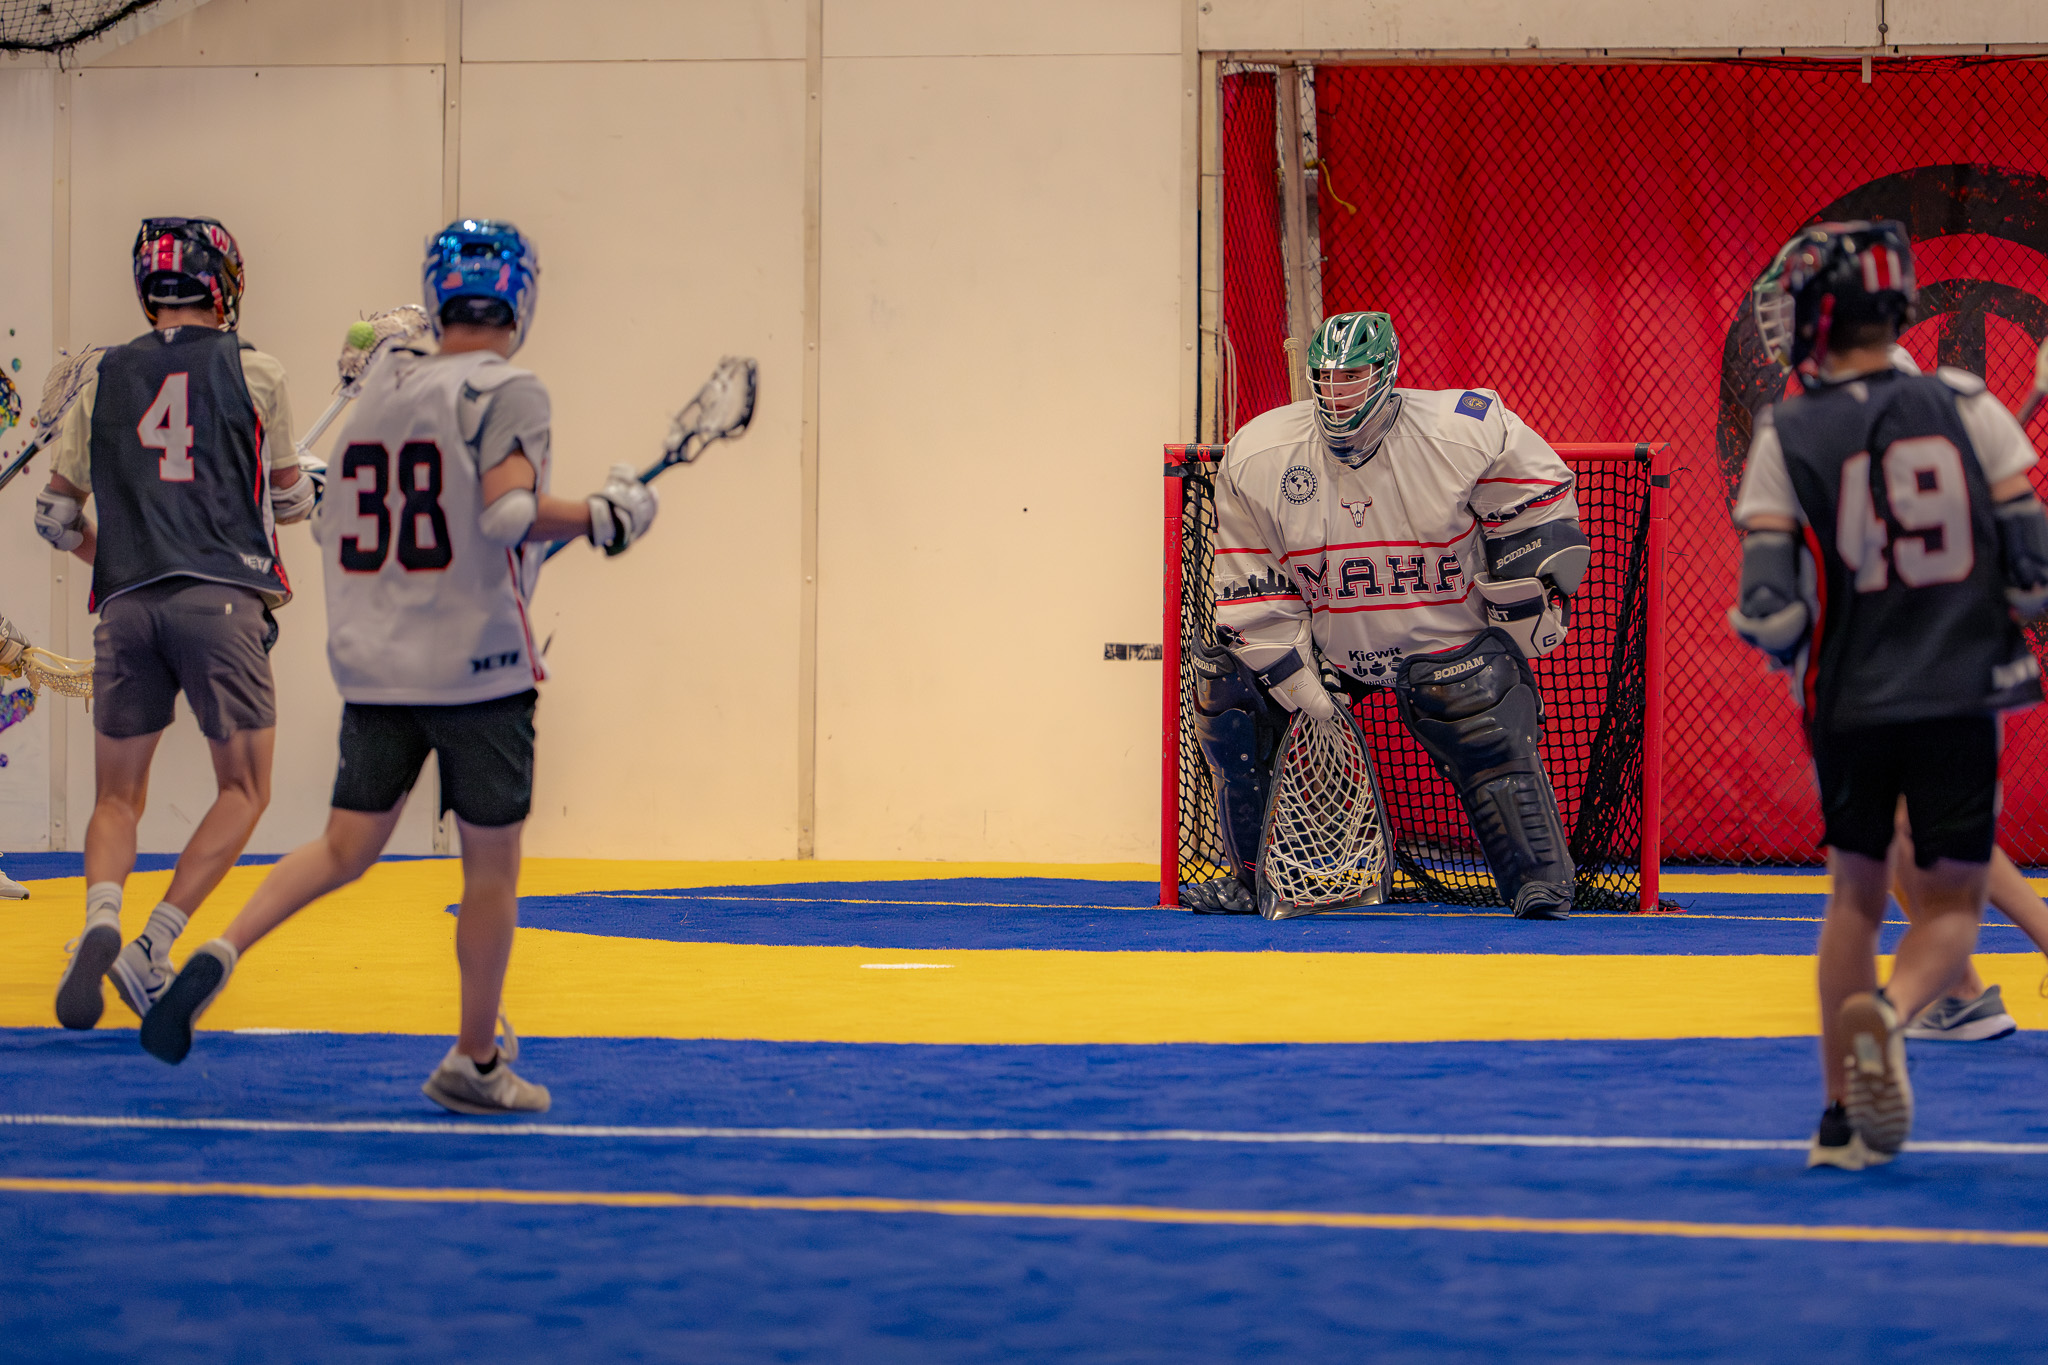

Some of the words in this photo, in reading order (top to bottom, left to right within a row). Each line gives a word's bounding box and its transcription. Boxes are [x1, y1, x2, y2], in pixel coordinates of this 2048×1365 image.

[137, 371, 194, 481] 4
[339, 440, 453, 574] 38
[1836, 434, 1974, 593] 49
[1496, 538, 1542, 570] BODDAM
[1348, 647, 1402, 661] Kiewit
[1433, 656, 1485, 680] BODDAM
